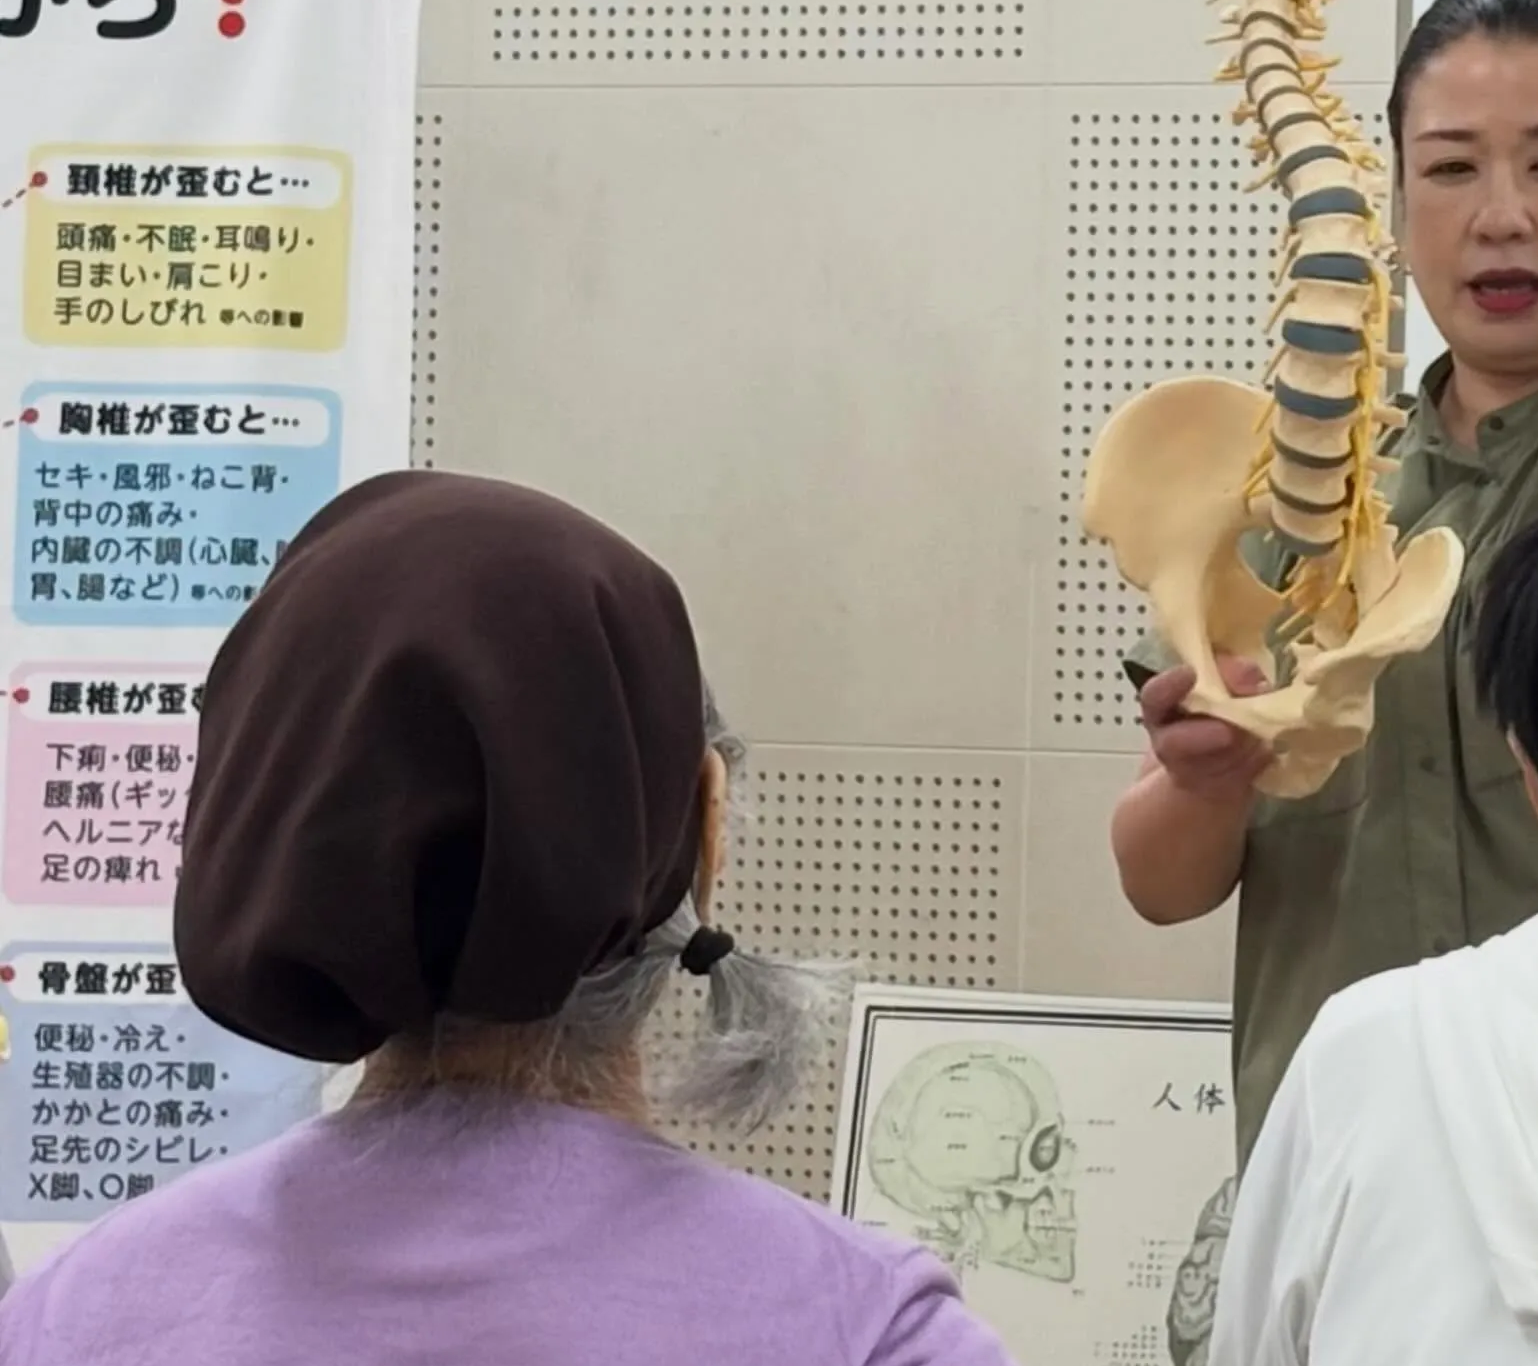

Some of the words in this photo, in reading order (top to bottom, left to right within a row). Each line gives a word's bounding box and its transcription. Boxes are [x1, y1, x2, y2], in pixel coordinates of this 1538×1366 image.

[54, 295, 206, 326] 手のしびれ
[33, 498, 197, 528] 背中の痛み・
[43, 779, 191, 810] 腰痛(ギッ
[34, 1022, 186, 1054] 便秘・冷え・
[31, 1097, 230, 1129] かかとの痛み・
[1150, 1081, 1226, 1115] 人体
